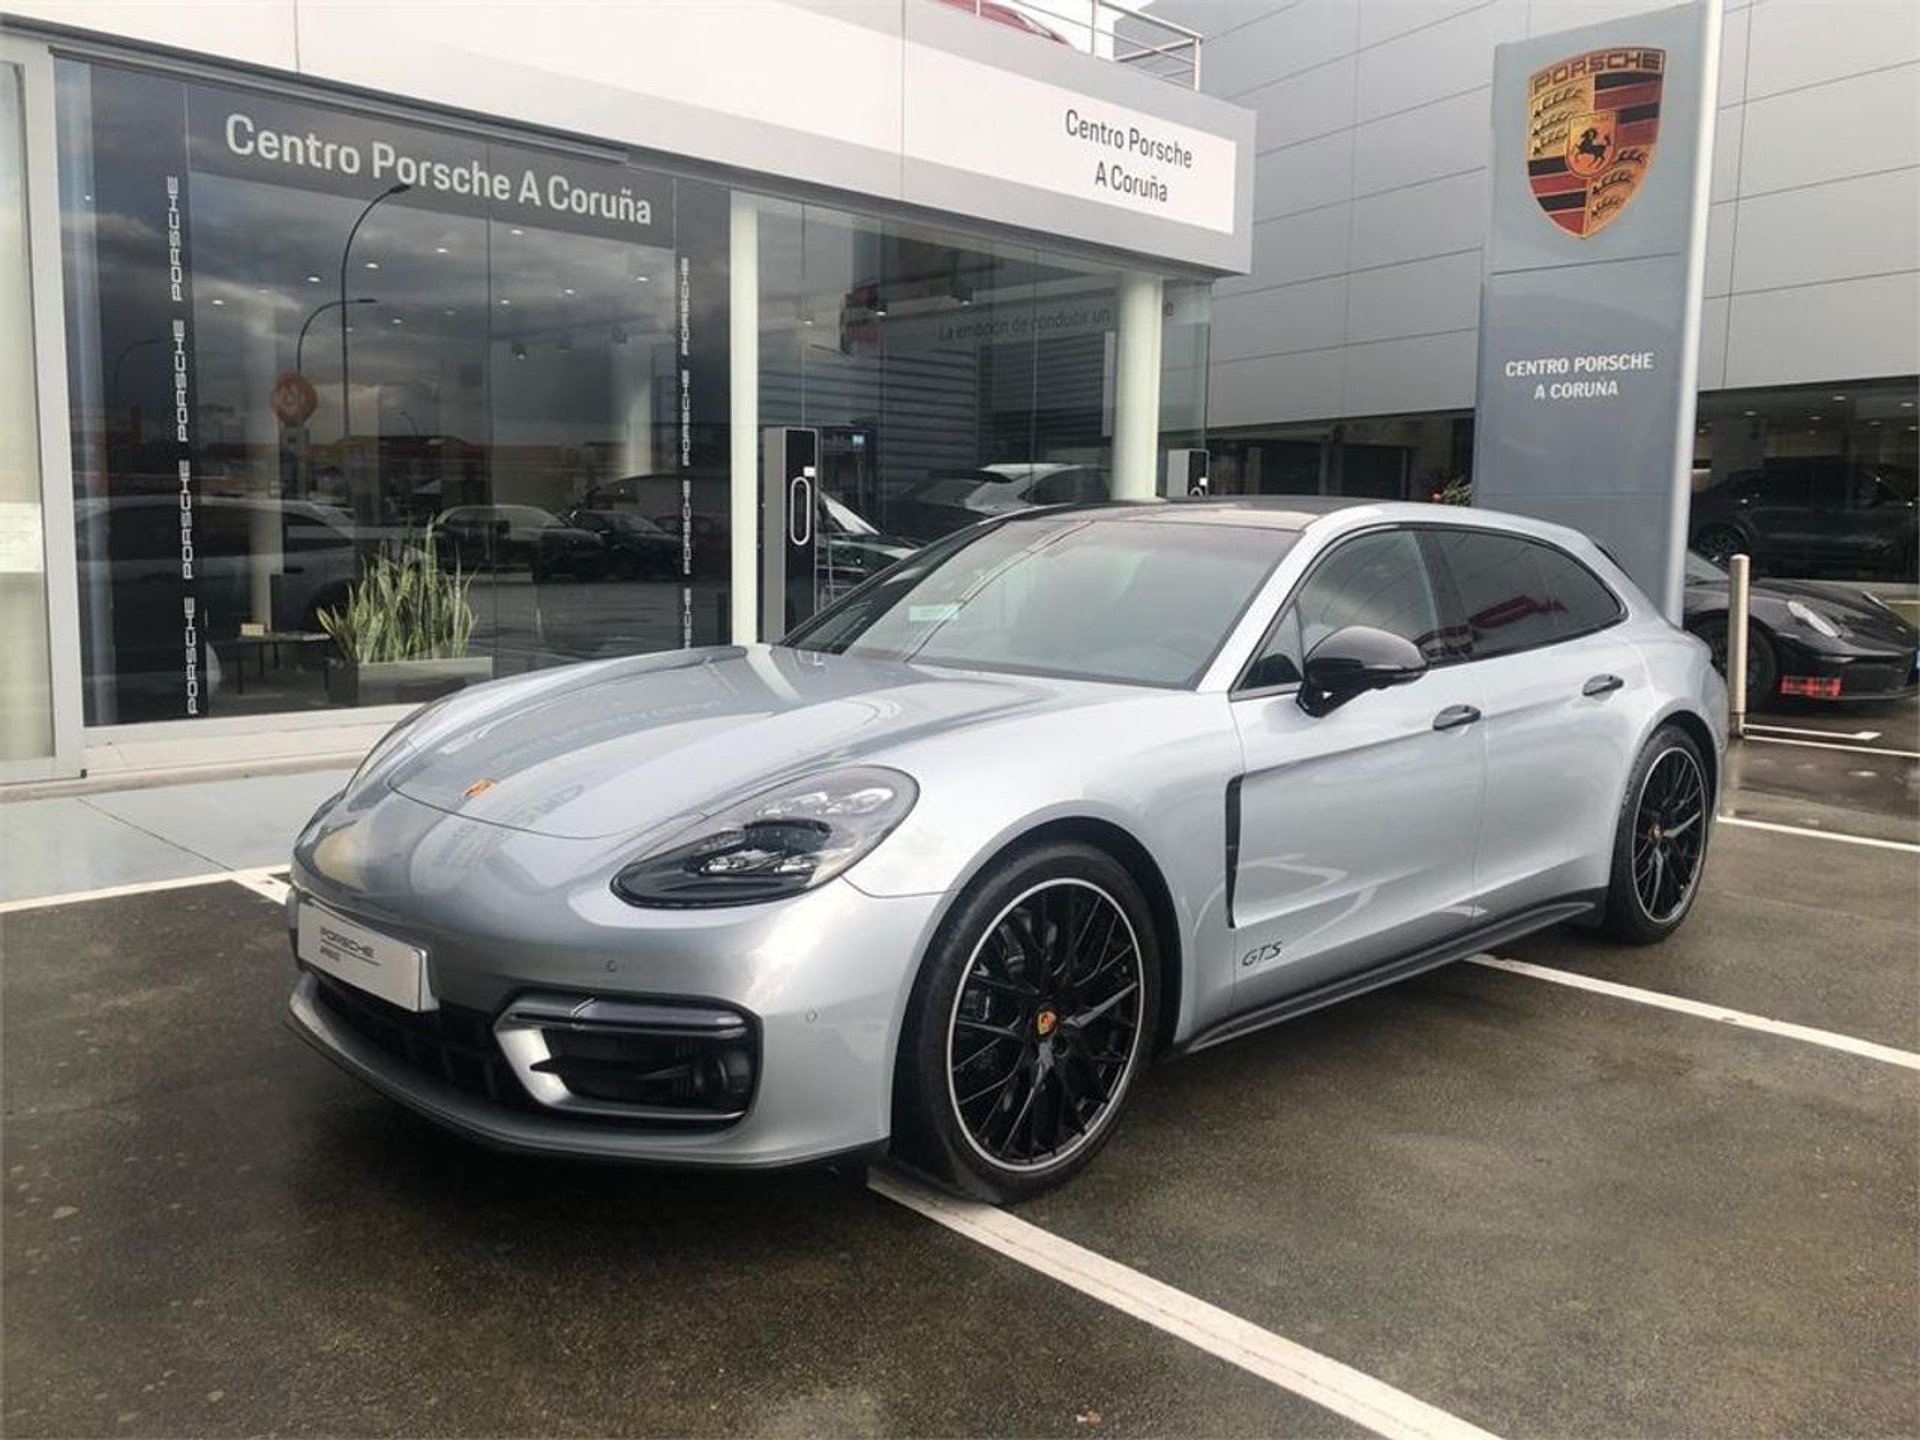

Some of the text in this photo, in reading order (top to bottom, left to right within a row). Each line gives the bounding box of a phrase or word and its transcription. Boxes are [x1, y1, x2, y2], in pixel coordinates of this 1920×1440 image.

[1533, 51, 1661, 94] PORSCHE
[226, 113, 651, 225] Centro Porsche A Coruña
[1065, 109, 1192, 168] Centro Porsche
[1095, 160, 1168, 202] A Coruña
[167, 175, 183, 302] PORSCHE
[173, 319, 189, 442] PORSCHE
[1505, 351, 1655, 377] CENTRO PORSCHE
[1534, 383, 1546, 399] A
[681, 369, 691, 467] PORSCHE
[178, 459, 193, 579] PORSCHE
[184, 597, 198, 715] PORSCHE
[1242, 941, 1282, 967] GTS
